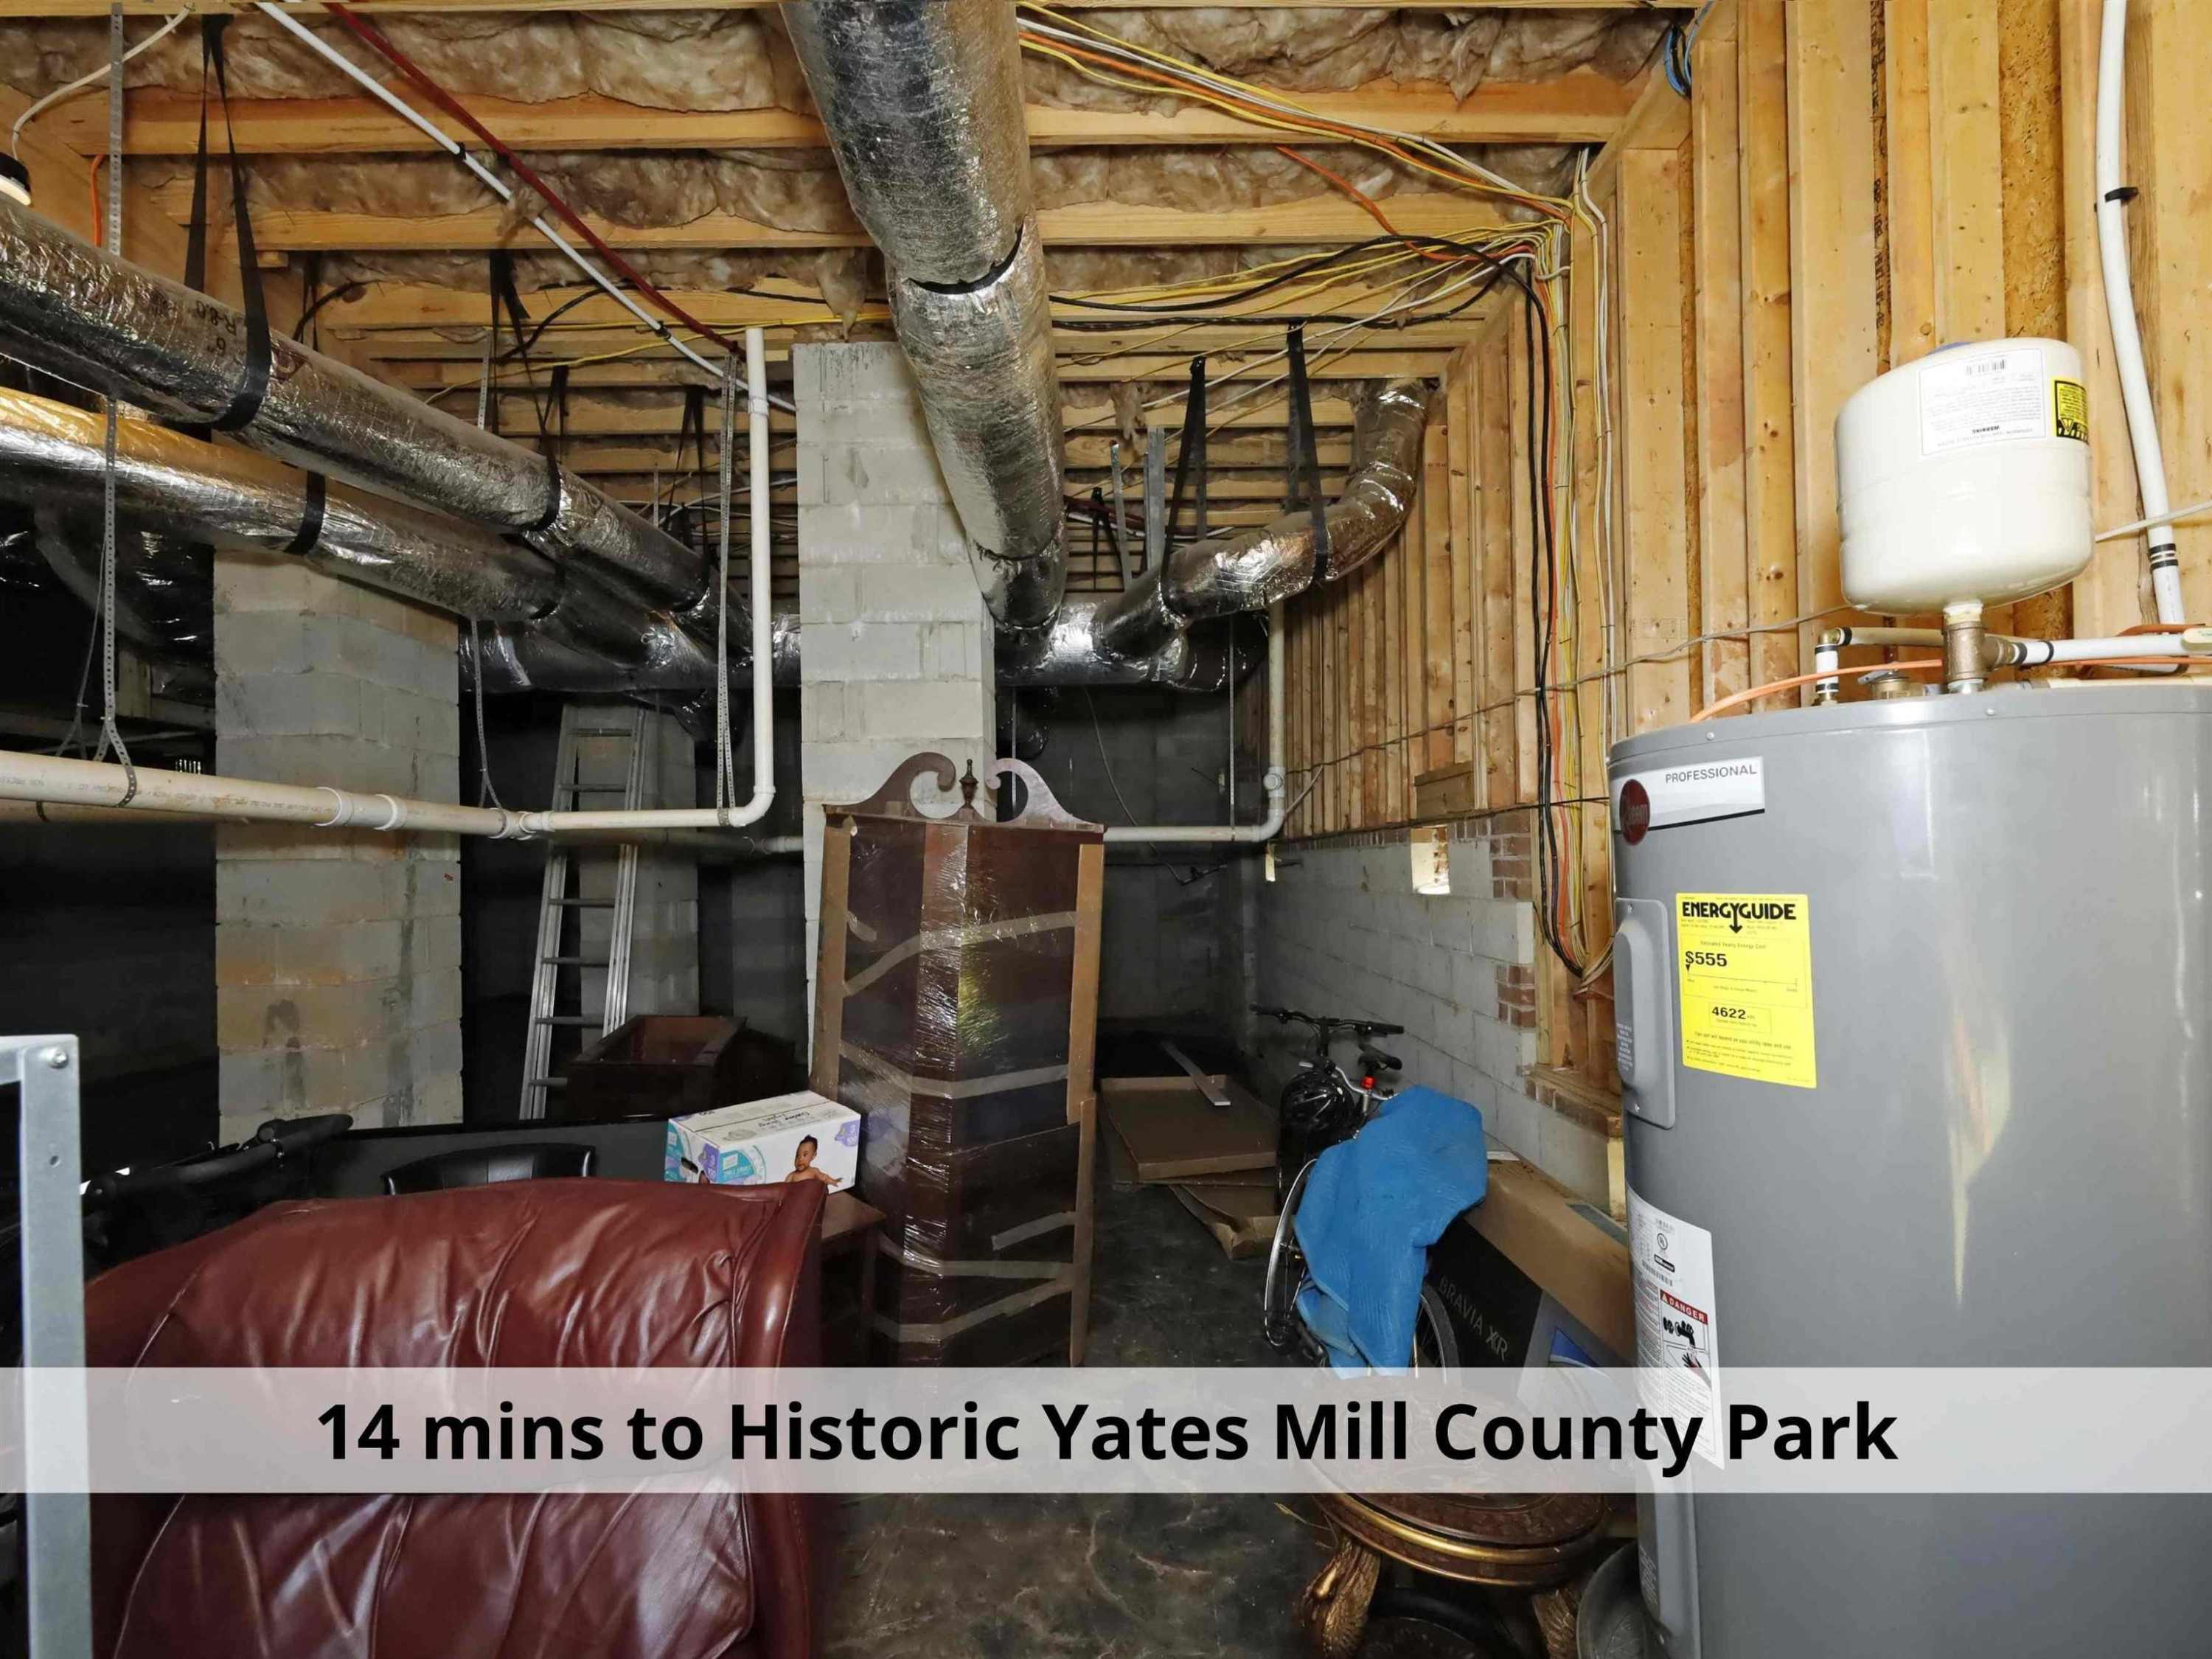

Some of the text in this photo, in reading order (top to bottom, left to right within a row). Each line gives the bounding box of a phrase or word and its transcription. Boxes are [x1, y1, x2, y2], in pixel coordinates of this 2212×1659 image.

[1971, 425, 2000, 435] WARNING
[1665, 764, 1758, 784] PROFESSIONAL
[1682, 901, 1797, 922] ENERGYGUIDE
[1685, 950, 1728, 967] $555
[1711, 1006, 1747, 1020] 4622
[1439, 1276, 1509, 1363] BRAVIA XR
[1669, 1297, 1705, 1323] DANGER
